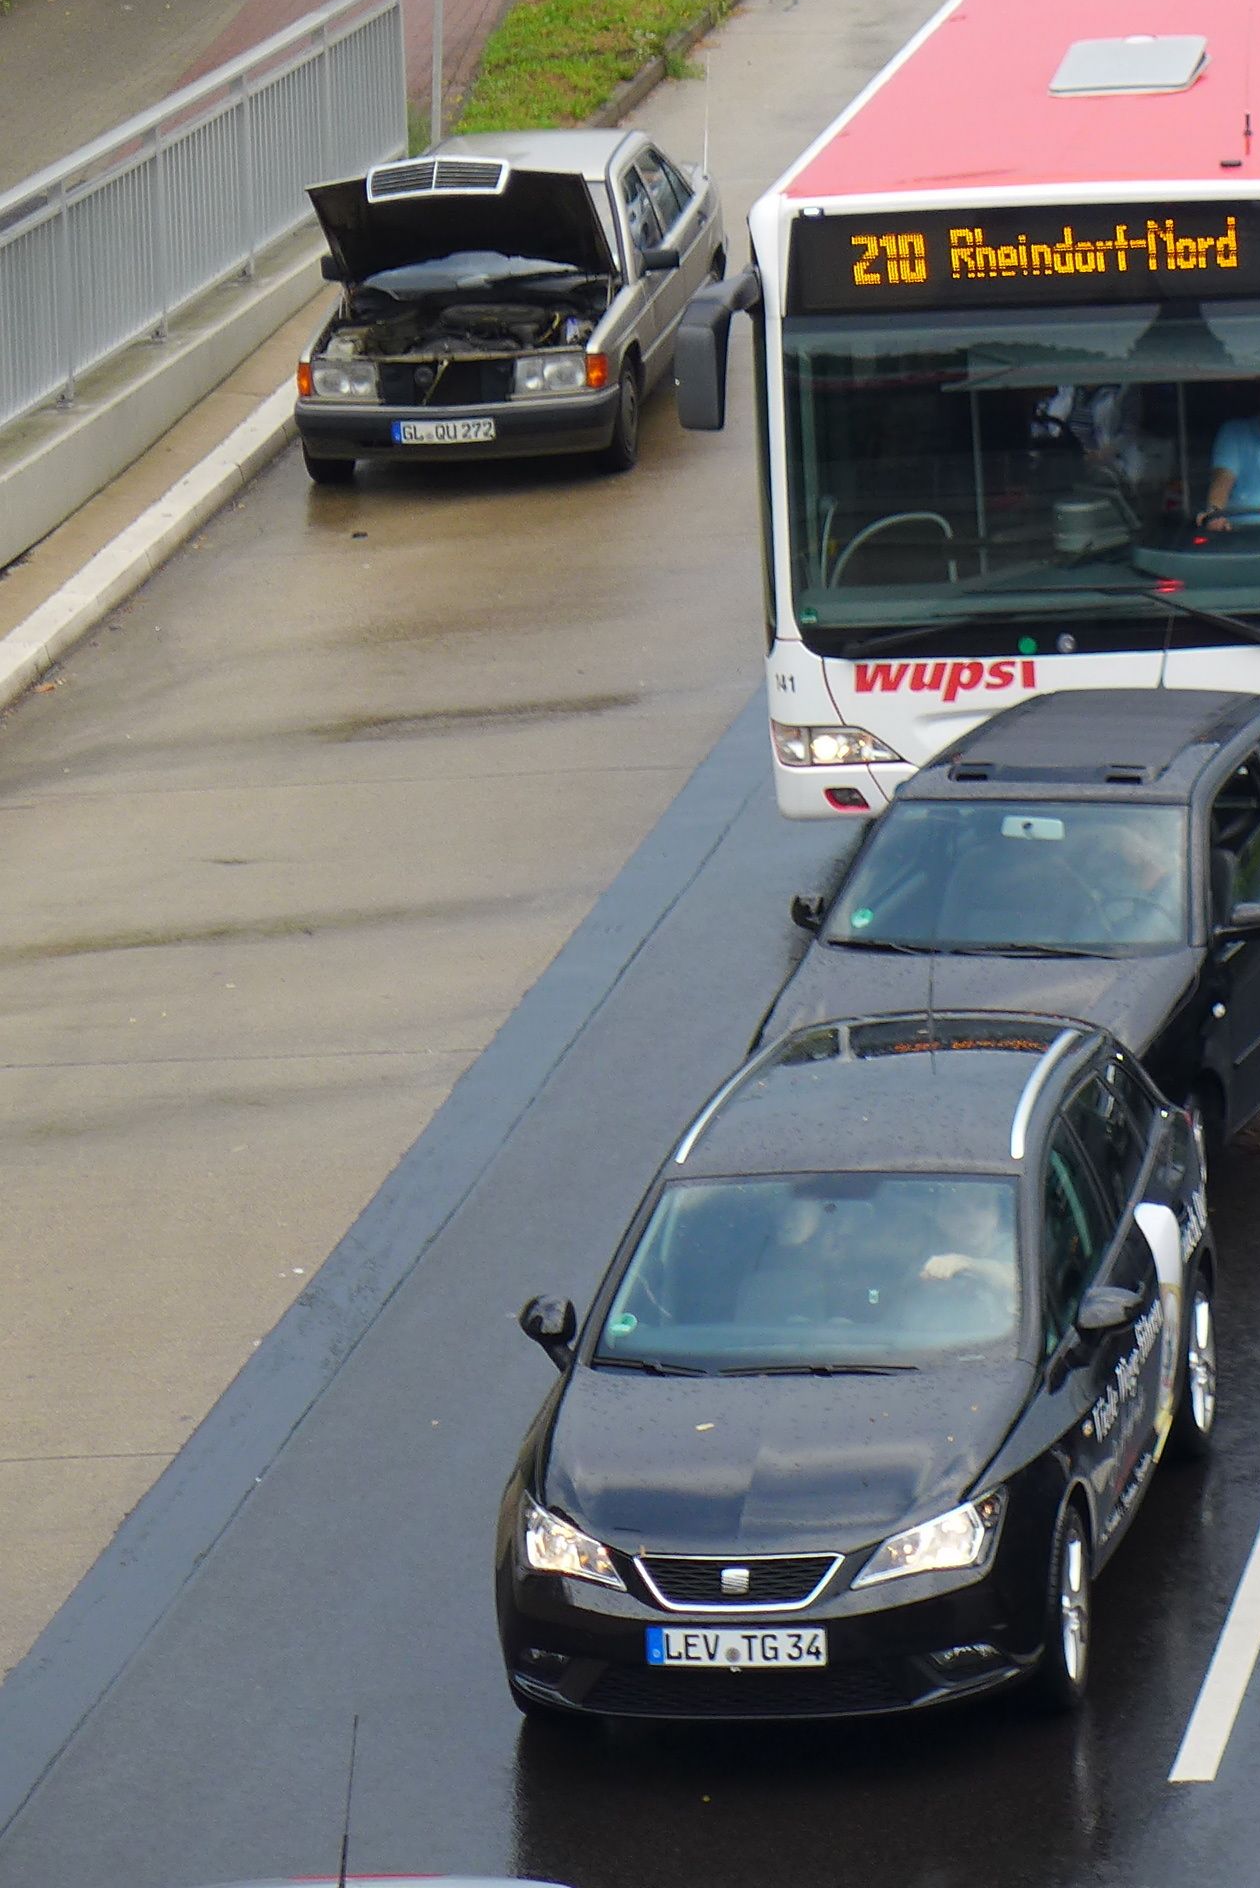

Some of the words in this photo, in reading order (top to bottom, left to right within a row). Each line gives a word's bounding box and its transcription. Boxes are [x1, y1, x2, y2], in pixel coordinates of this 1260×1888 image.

[851, 231, 928, 285] 210
[949, 215, 1239, 279] Rheindorf-Nord
[402, 424, 425, 441] GL
[434, 422, 458, 441] QU
[461, 421, 494, 440] 272
[854, 659, 1037, 703] wupsi
[664, 1632, 721, 1661] LEV
[740, 1633, 779, 1661] TG
[786, 1633, 822, 1661] 34
